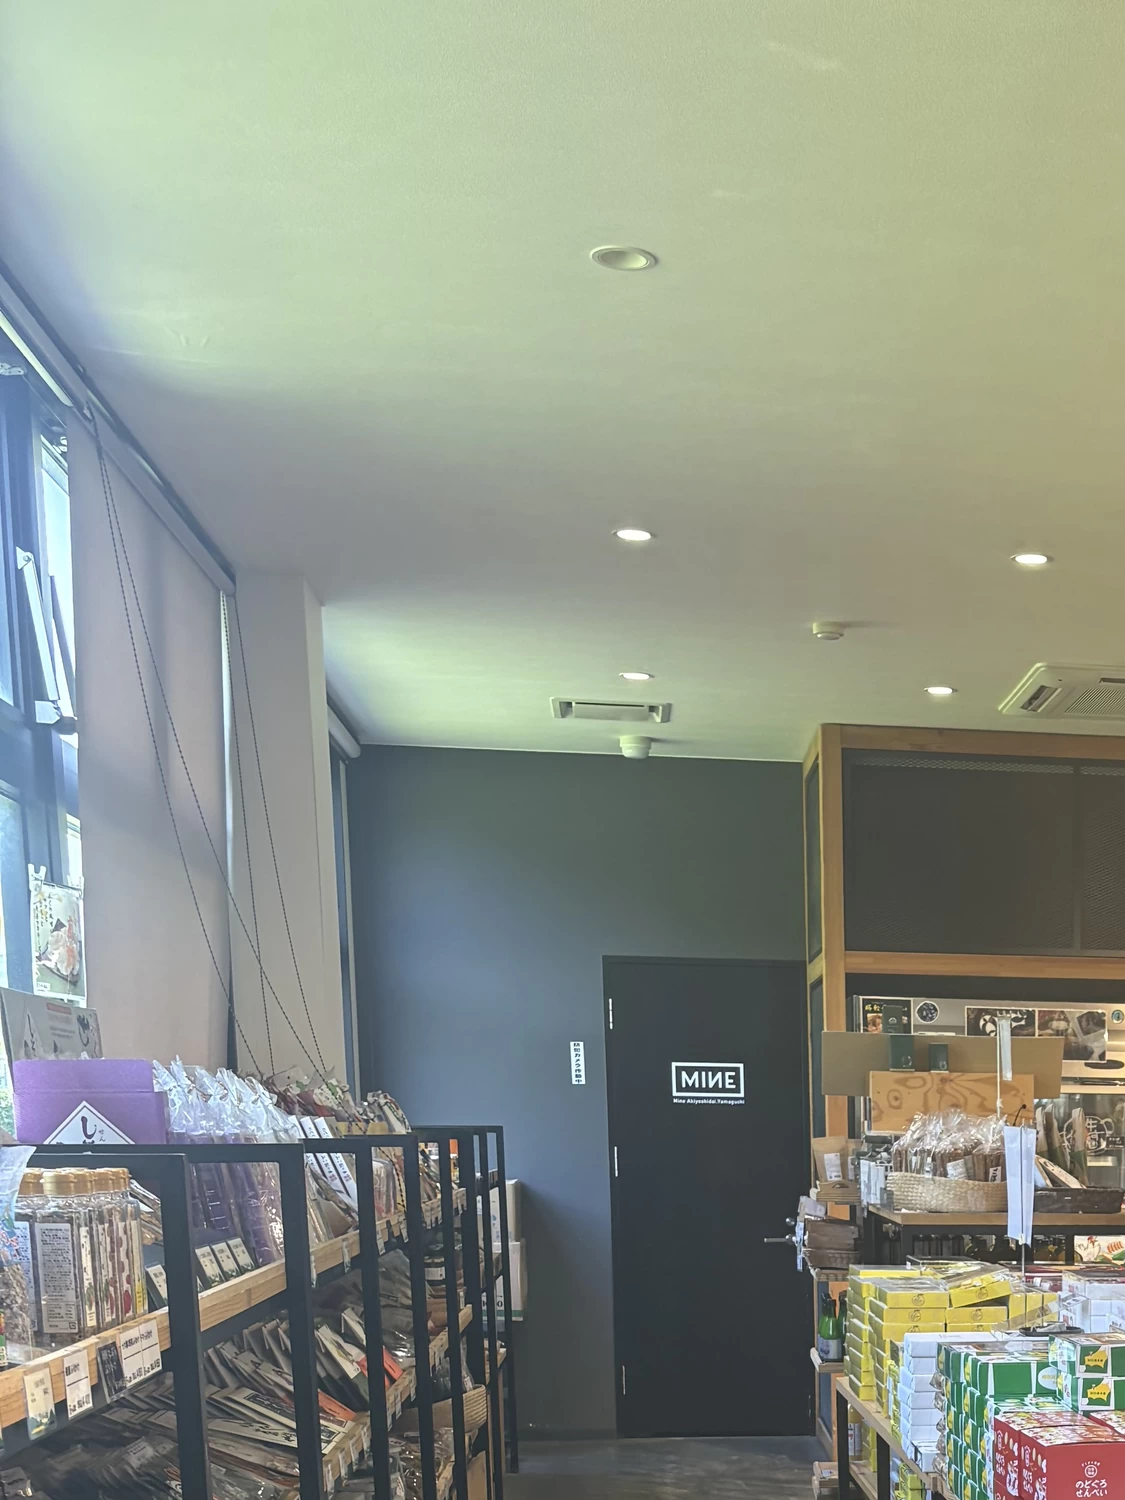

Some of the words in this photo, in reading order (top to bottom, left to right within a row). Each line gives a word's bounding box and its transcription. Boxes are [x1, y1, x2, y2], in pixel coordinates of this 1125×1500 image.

[1075, 1479, 1107, 1489] のどぐろ
[1076, 1489, 1108, 1497] せんべい
